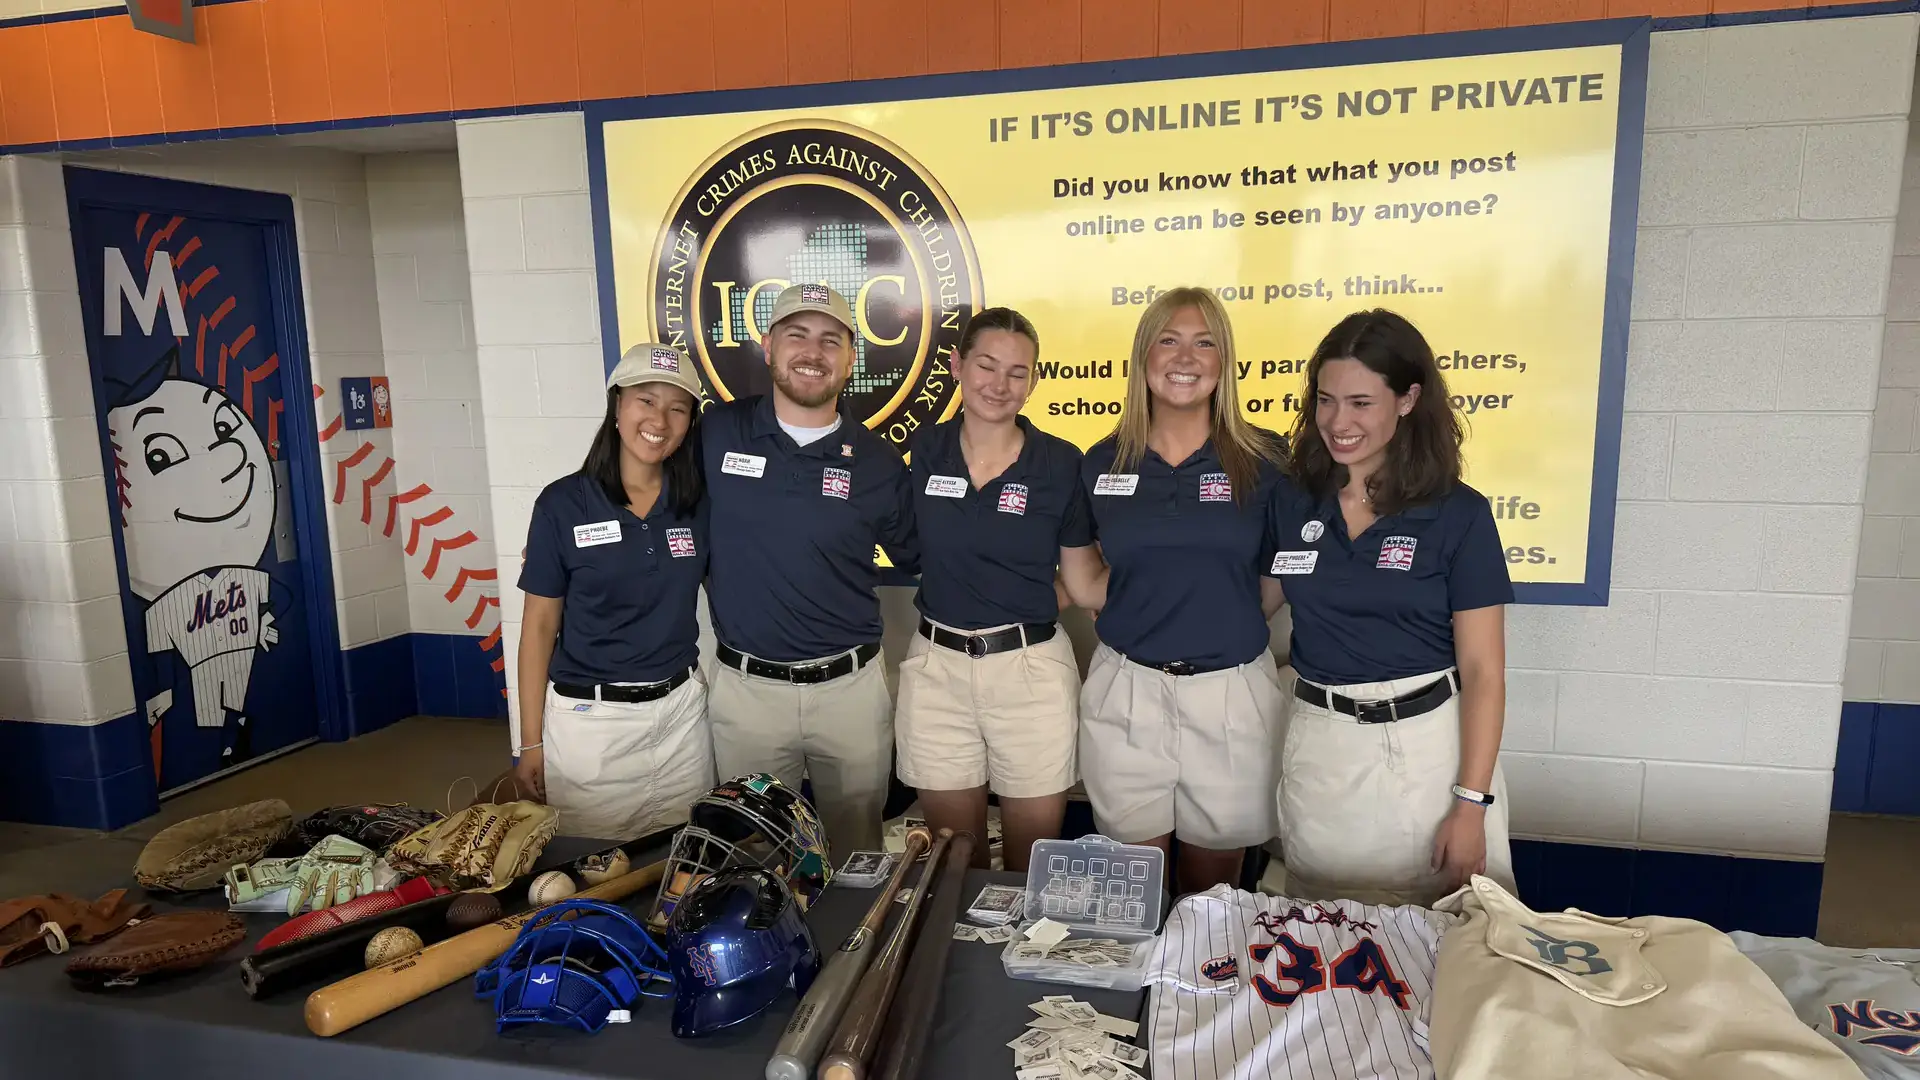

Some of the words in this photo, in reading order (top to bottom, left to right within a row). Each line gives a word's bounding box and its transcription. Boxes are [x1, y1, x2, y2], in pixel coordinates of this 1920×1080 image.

[989, 117, 1018, 142] IF
[1032, 109, 1094, 140] IT'S
[1105, 100, 1241, 135] ONLINE
[1255, 93, 1323, 124] IT'S
[1337, 87, 1418, 118] NOT
[1431, 73, 1604, 111] PRIVATE
[697, 149, 777, 217] CRIMES
[787, 143, 898, 192] AGAINST
[1054, 177, 1094, 198] Did
[1102, 177, 1149, 201] you
[1159, 172, 1232, 193] know
[1240, 165, 1297, 186] that
[1306, 159, 1378, 182] what
[1388, 159, 1440, 183] you
[1451, 151, 1516, 179] post
[1066, 213, 1145, 237] online
[1154, 214, 1202, 231] can
[1212, 209, 1245, 229] be
[1254, 208, 1322, 227] seen
[1331, 202, 1366, 227] by
[1374, 194, 1499, 222] anyone?
[900, 190, 960, 331] CHILDREN
[104, 246, 189, 336] M
[665, 221, 699, 356] NTERNET
[712, 274, 909, 346] ICC
[1112, 285, 1166, 306] Bef
[1264, 277, 1333, 305] post,
[1344, 273, 1444, 299] think...
[915, 344, 957, 411] TASK
[1038, 360, 1112, 379] Would
[1435, 350, 1527, 373] chers,
[1048, 397, 1126, 416] schoo
[1246, 398, 1275, 413] or
[187, 581, 247, 633] Mets
[230, 617, 248, 636] 00
[1249, 932, 1412, 1010] 34
